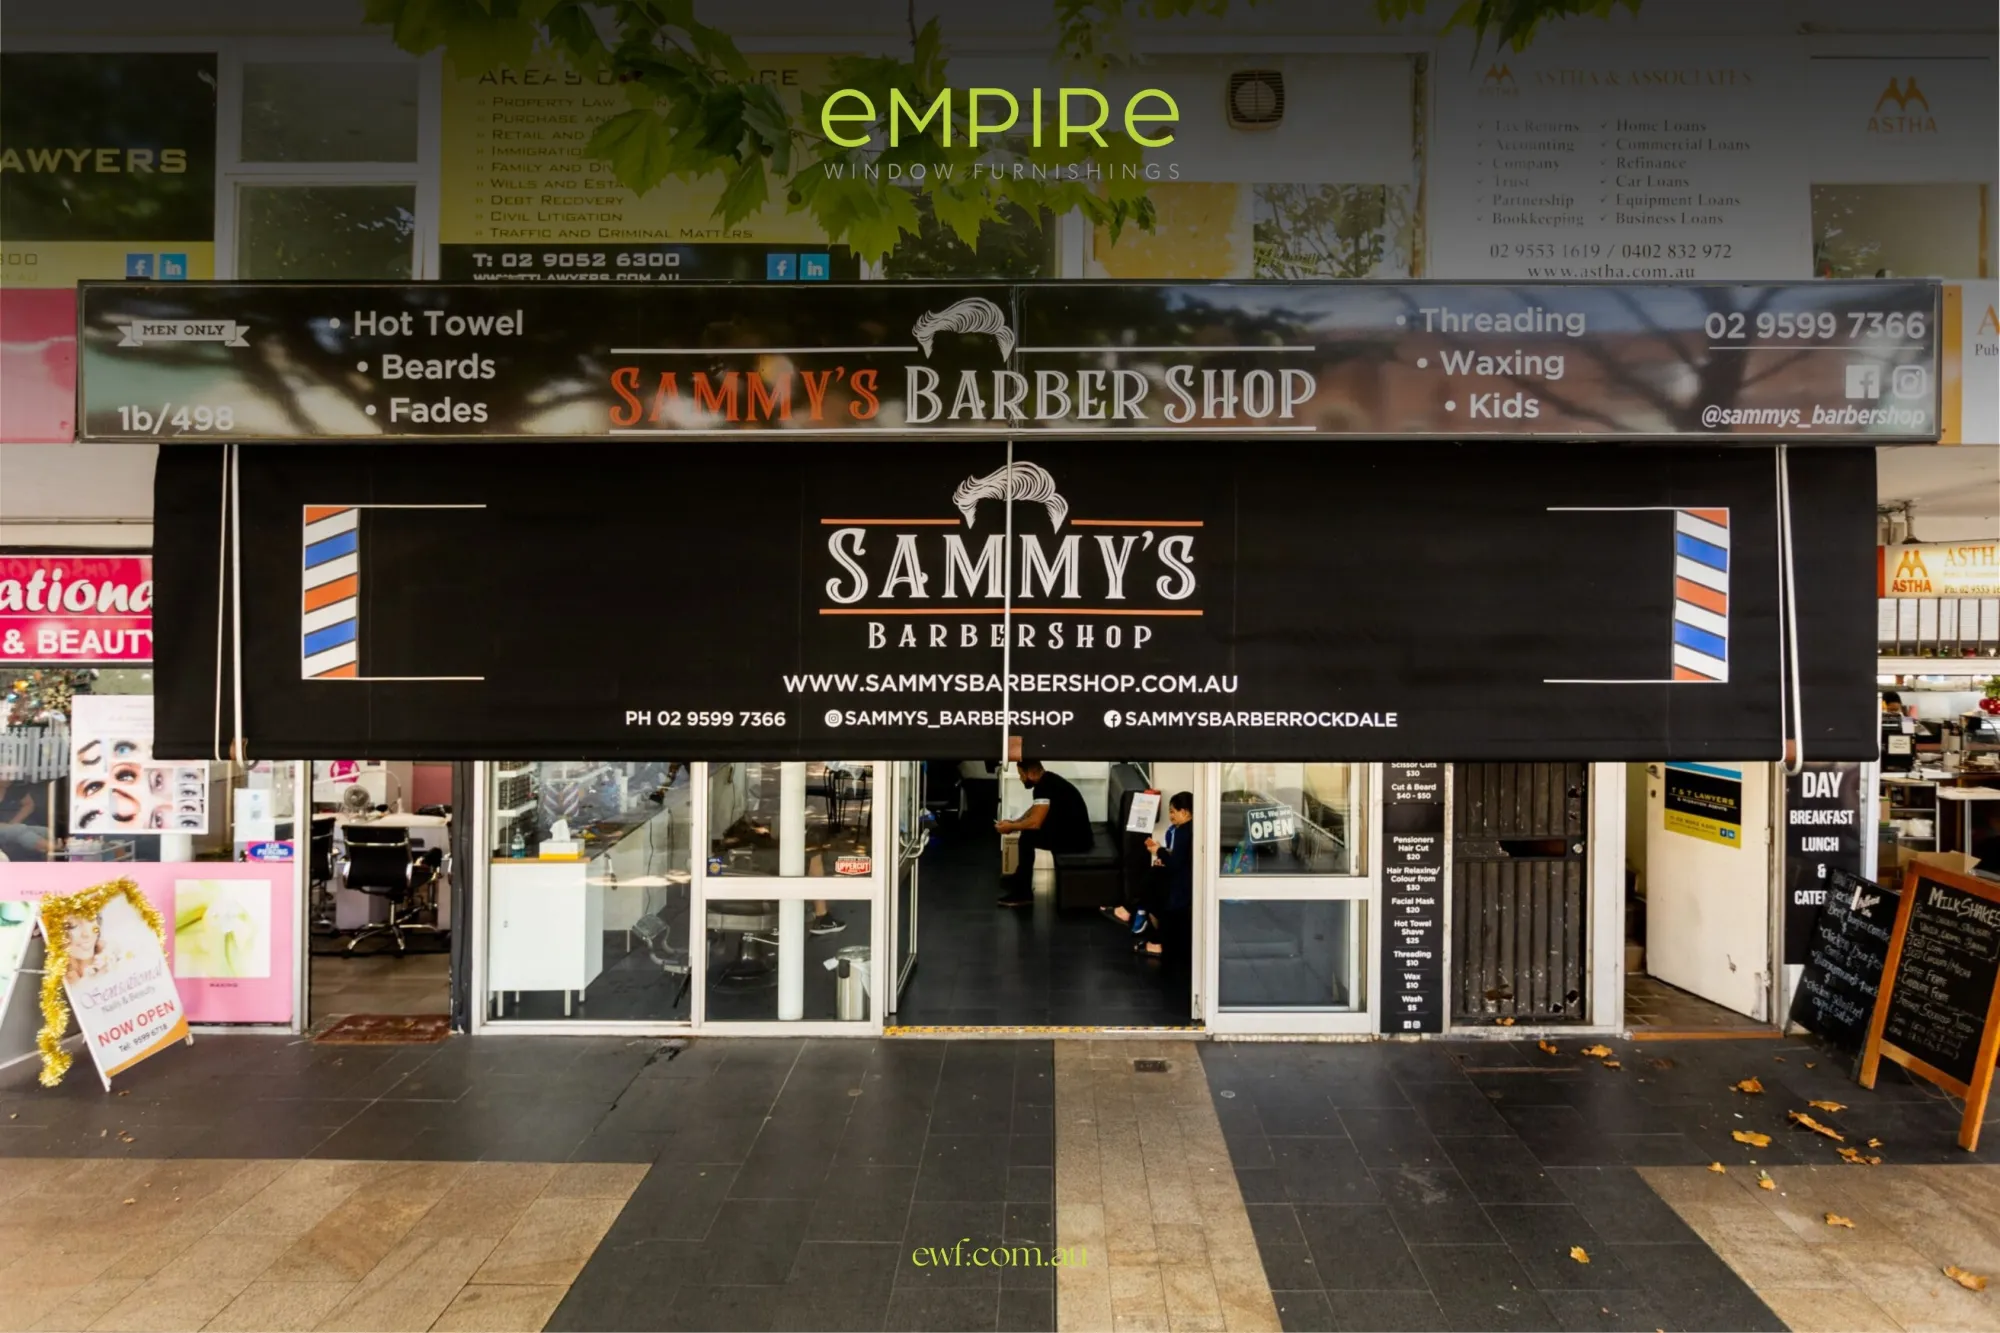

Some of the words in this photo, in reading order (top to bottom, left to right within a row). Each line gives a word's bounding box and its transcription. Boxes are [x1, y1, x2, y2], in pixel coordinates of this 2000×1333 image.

[1605, 69, 1621, 86] &
[1616, 118, 1659, 132] Home
[1664, 118, 1707, 132] Loans
[1867, 116, 1938, 134] ASTHA
[1616, 137, 1703, 150] Commercial
[1708, 138, 1751, 151] Loans
[1616, 156, 1687, 170] Refinance
[1495, 175, 1530, 188] Trust
[1616, 175, 1641, 188] Car
[1646, 175, 1690, 188] Loans
[1492, 193, 1575, 209] Partnership
[1616, 194, 1693, 208] Equipment
[1698, 193, 1741, 206] Loans
[1492, 212, 1585, 227] Bookkeeping
[1616, 212, 1677, 225] Business
[1681, 212, 1724, 225] Loans
[1489, 244, 1509, 259] 02
[1515, 244, 1555, 259] 9553
[1562, 244, 1601, 259] 1619
[1621, 244, 1662, 259] 0402
[1667, 244, 1697, 259] 832
[1702, 244, 1732, 259] 972
[502, 253, 533, 267] 02
[543, 253, 606, 267] 9052
[616, 253, 680, 267] 6300
[1527, 264, 1696, 279] www.astha.com.au
[354, 310, 413, 336] Hot
[423, 309, 523, 336] Towel
[1419, 307, 1586, 337] Threading
[1704, 312, 1746, 339] 02
[1756, 312, 1837, 339] 9599
[1848, 312, 1926, 339] 7366
[142, 325, 177, 336] MEN
[184, 325, 226, 336] ONLY
[382, 353, 496, 380] Beards
[1439, 349, 1565, 380] Waxing
[609, 366, 879, 426] SAMMY'S
[904, 365, 1149, 424] BARBER
[1164, 365, 1317, 424] SHOP
[390, 396, 488, 423] Fades
[1470, 392, 1540, 419] Kids
[117, 403, 234, 434] 1b/498
[1701, 404, 1925, 428] @sammys_barbershop
[825, 527, 1197, 604] SAMMY'S
[1891, 579, 1932, 593] ASTHA
[3, 629, 25, 654] &
[868, 621, 1152, 650] BARBERSHOP
[783, 674, 1239, 694] WWW.SAMMYSBARBERSHOP.COM.AU
[625, 711, 652, 726] PH
[657, 711, 682, 726] 02
[687, 711, 734, 727] 9599
[740, 711, 787, 727] 7366
[845, 711, 1074, 728] SAMMYS_BARBERSHOP
[1125, 711, 1398, 728] SAMMYSBARBERROCKDALE
[1802, 771, 1843, 798] DAY
[1790, 810, 1855, 825] BREAKFAST
[1251, 818, 1293, 839] OPEN
[1802, 837, 1840, 852] LUNCH
[1391, 875, 1416, 883] Colour
[1817, 863, 1827, 879] &
[1391, 897, 1414, 905] Facial
[1415, 897, 1435, 905] Mask
[1393, 950, 1432, 959] Threading
[1406, 959, 1419, 967] $10
[1401, 995, 1423, 1003] Wash
[97, 1019, 134, 1047] NOW
[136, 1000, 175, 1027] OPEN
